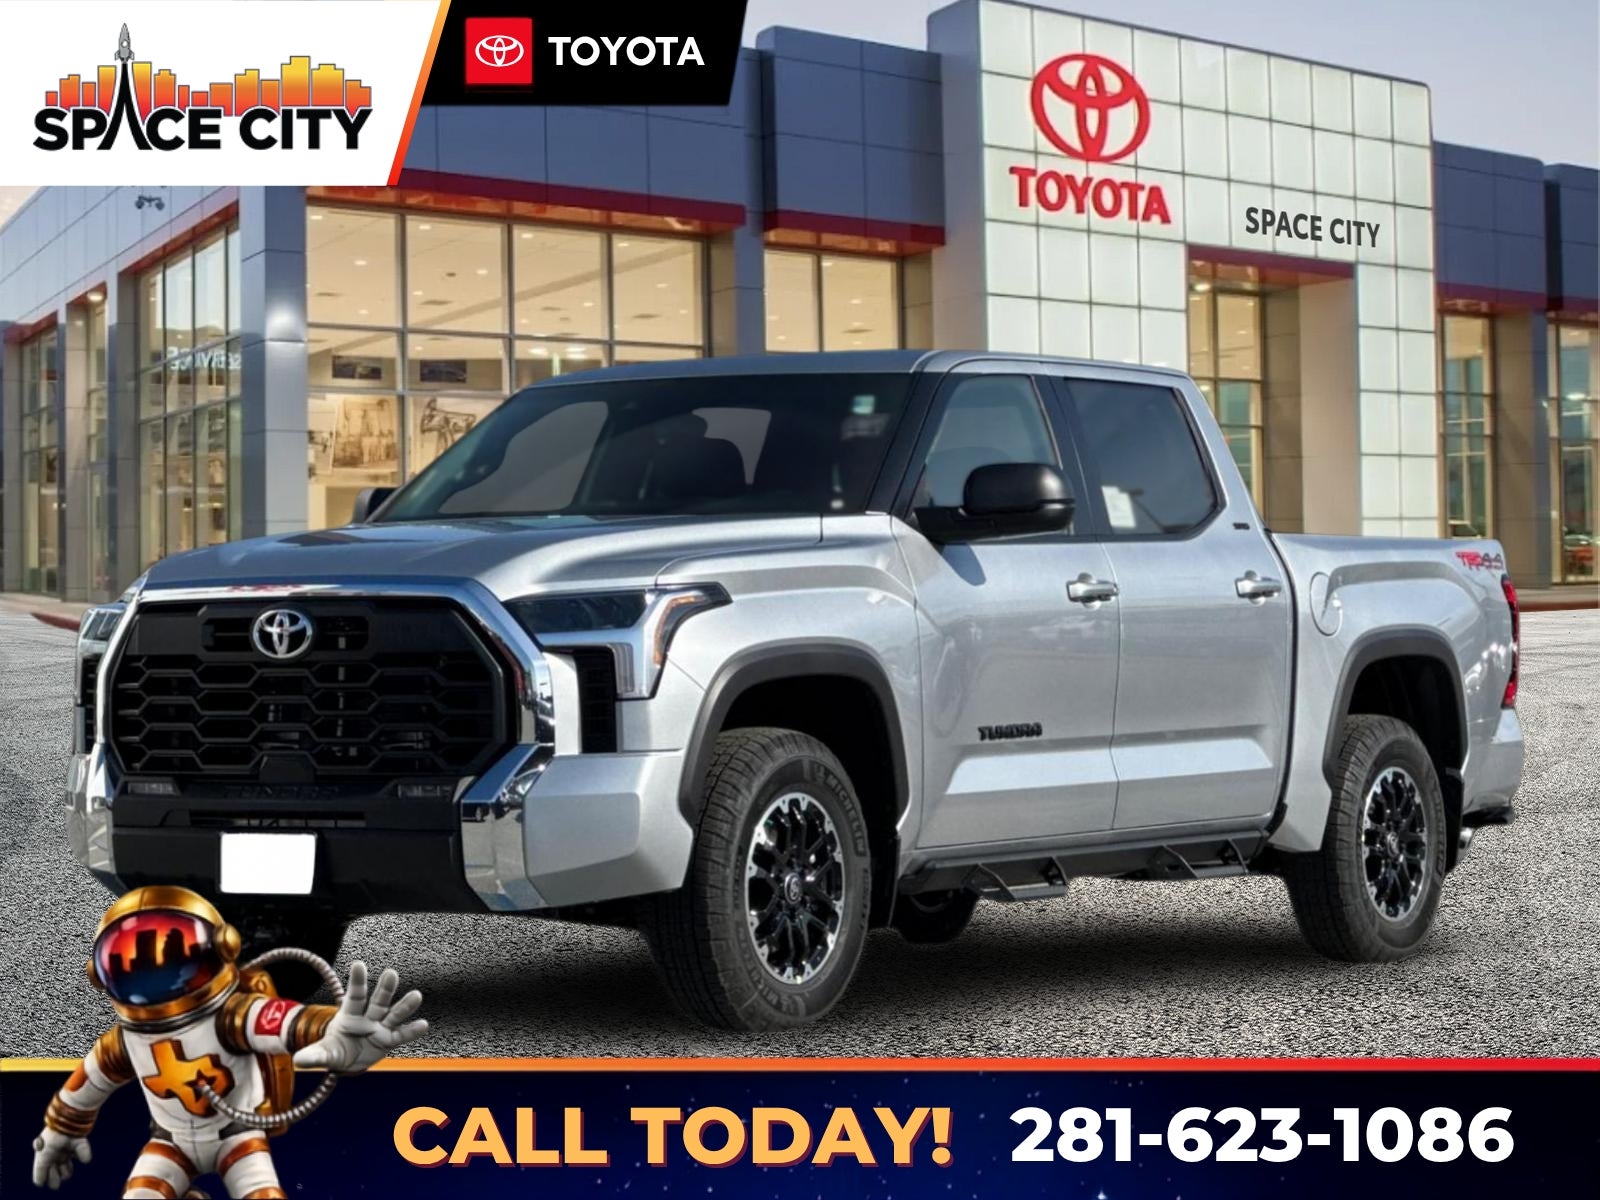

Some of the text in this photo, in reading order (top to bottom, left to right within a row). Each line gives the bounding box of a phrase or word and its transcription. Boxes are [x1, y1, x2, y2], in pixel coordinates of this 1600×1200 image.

[1009, 167, 1171, 224] TOYOTA
[1245, 206, 1381, 249] SPACE CITY
